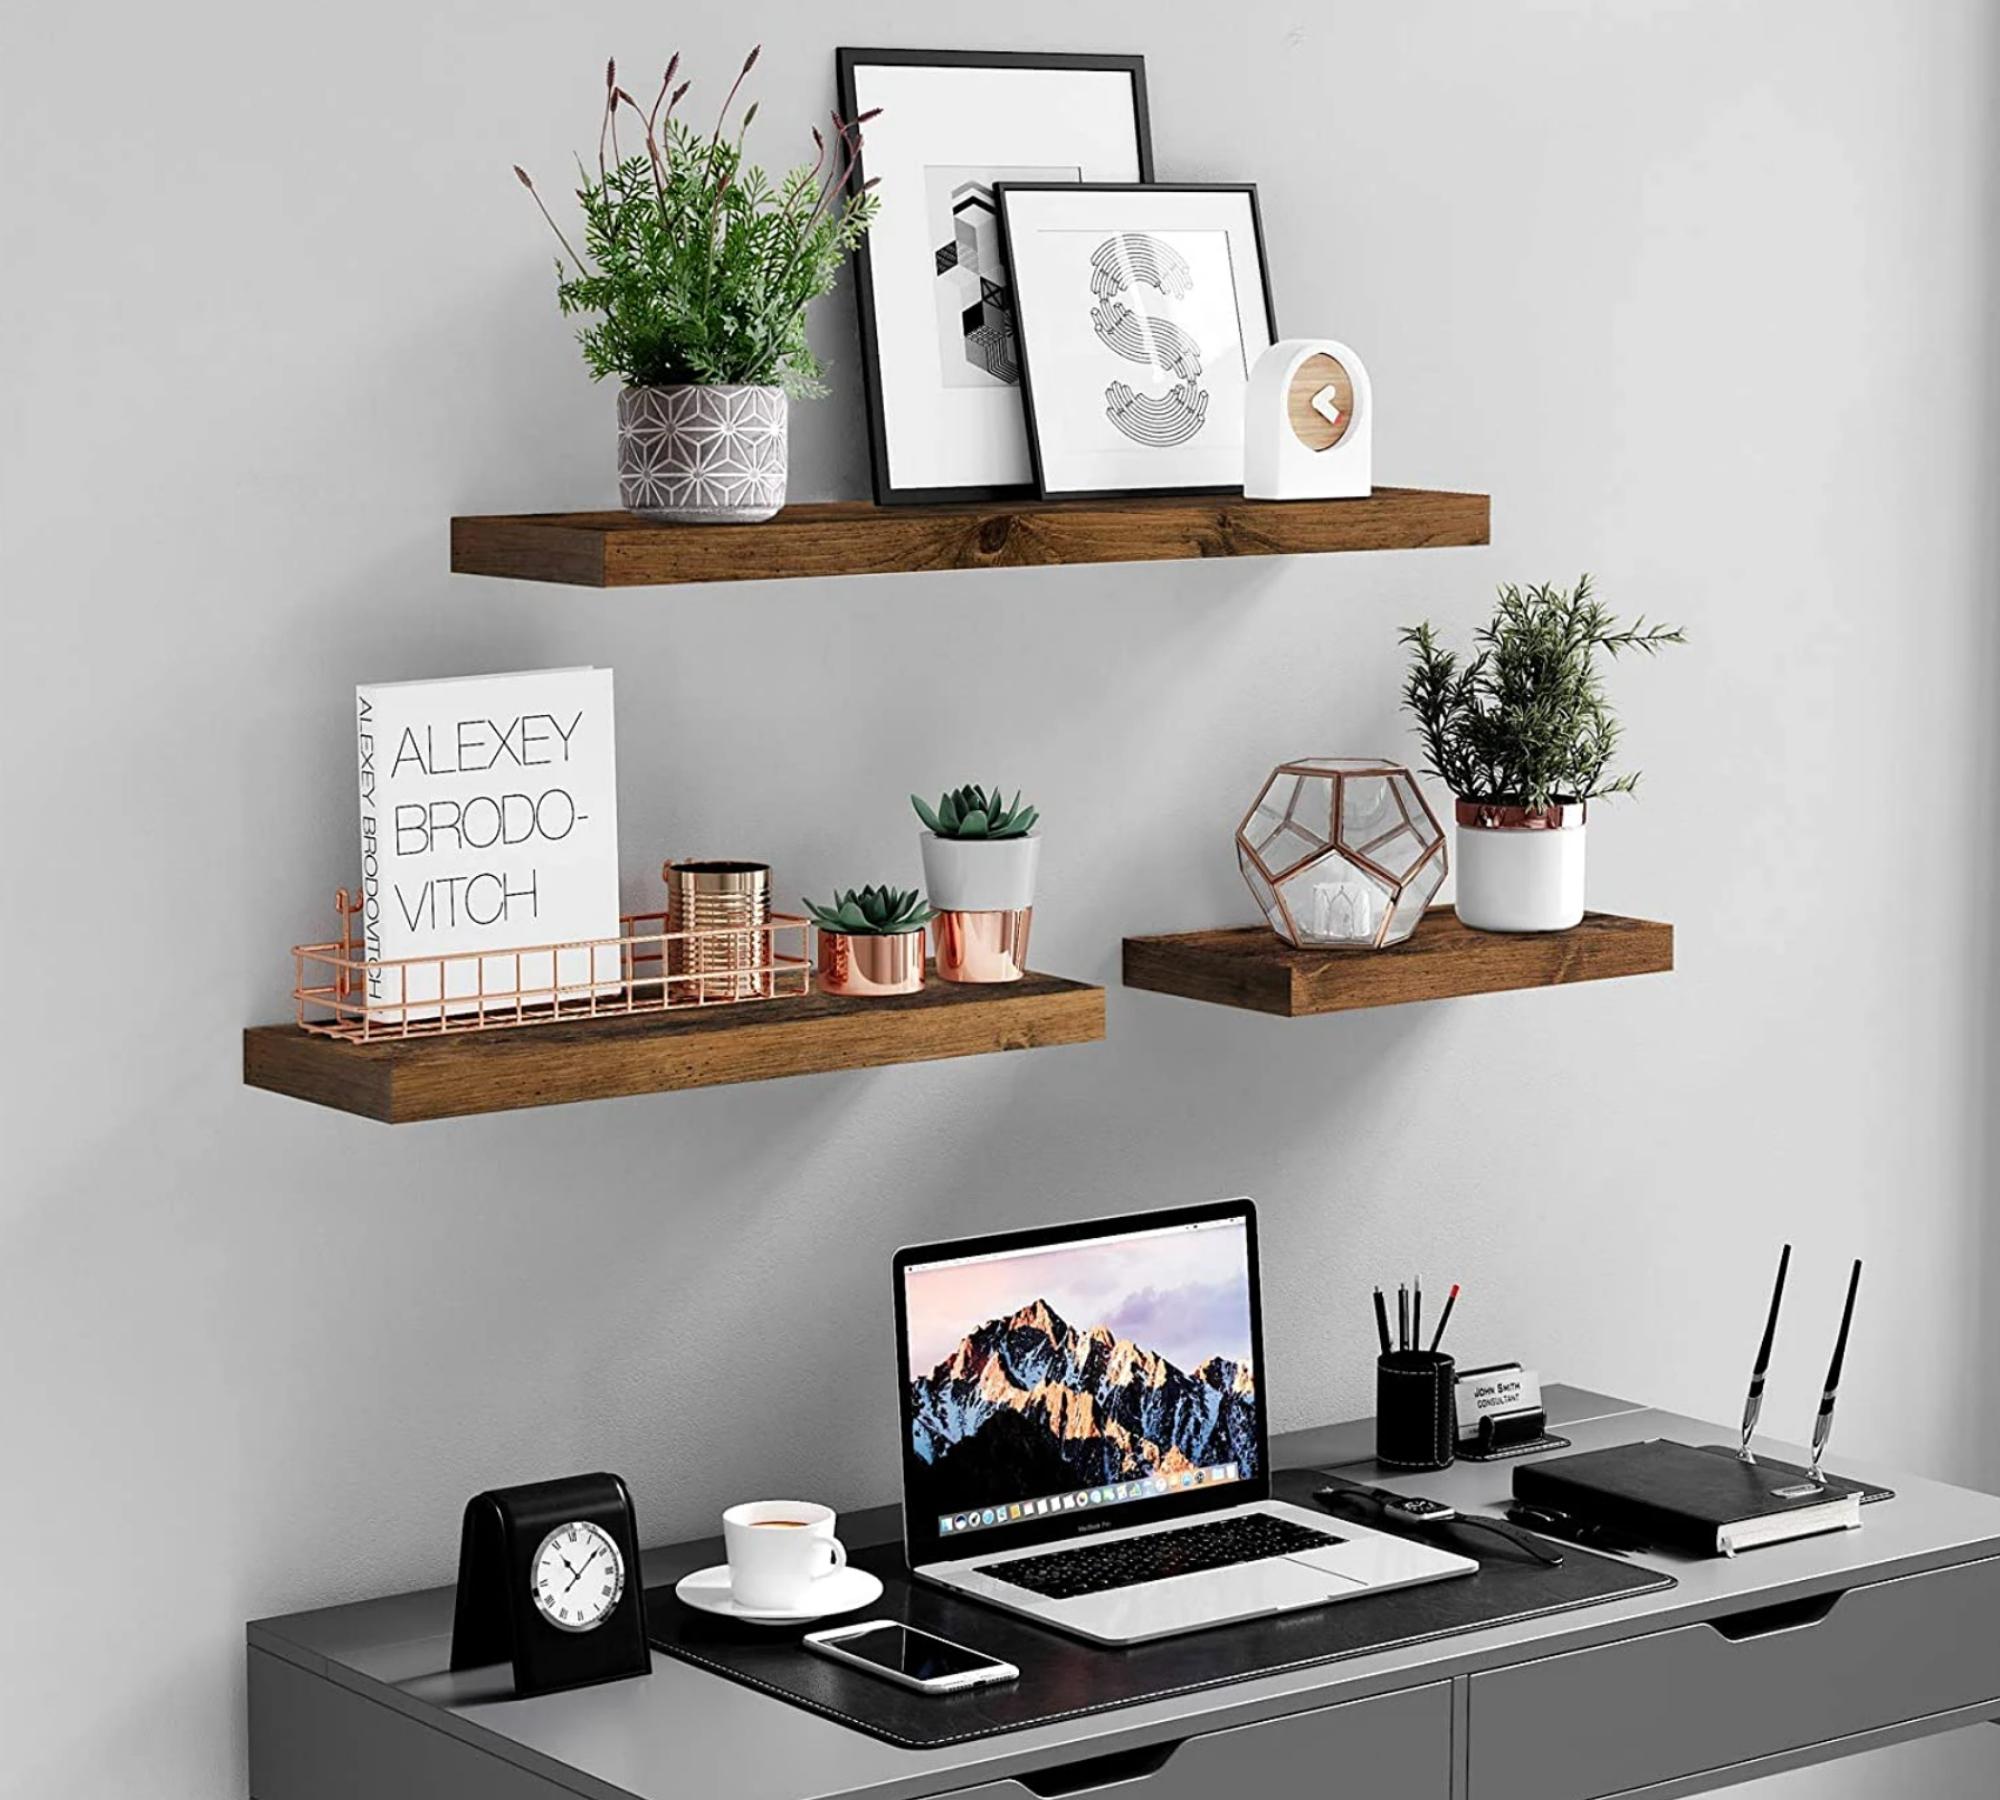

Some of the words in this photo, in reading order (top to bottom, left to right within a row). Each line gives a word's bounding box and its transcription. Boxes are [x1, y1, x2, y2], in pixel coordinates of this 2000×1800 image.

[359, 696, 375, 807] ALEXEY
[390, 711, 583, 778] ALEXEY
[395, 789, 589, 856] BRODO-
[362, 816, 382, 999] BRODOVITCH
[394, 869, 537, 932] VITCH
